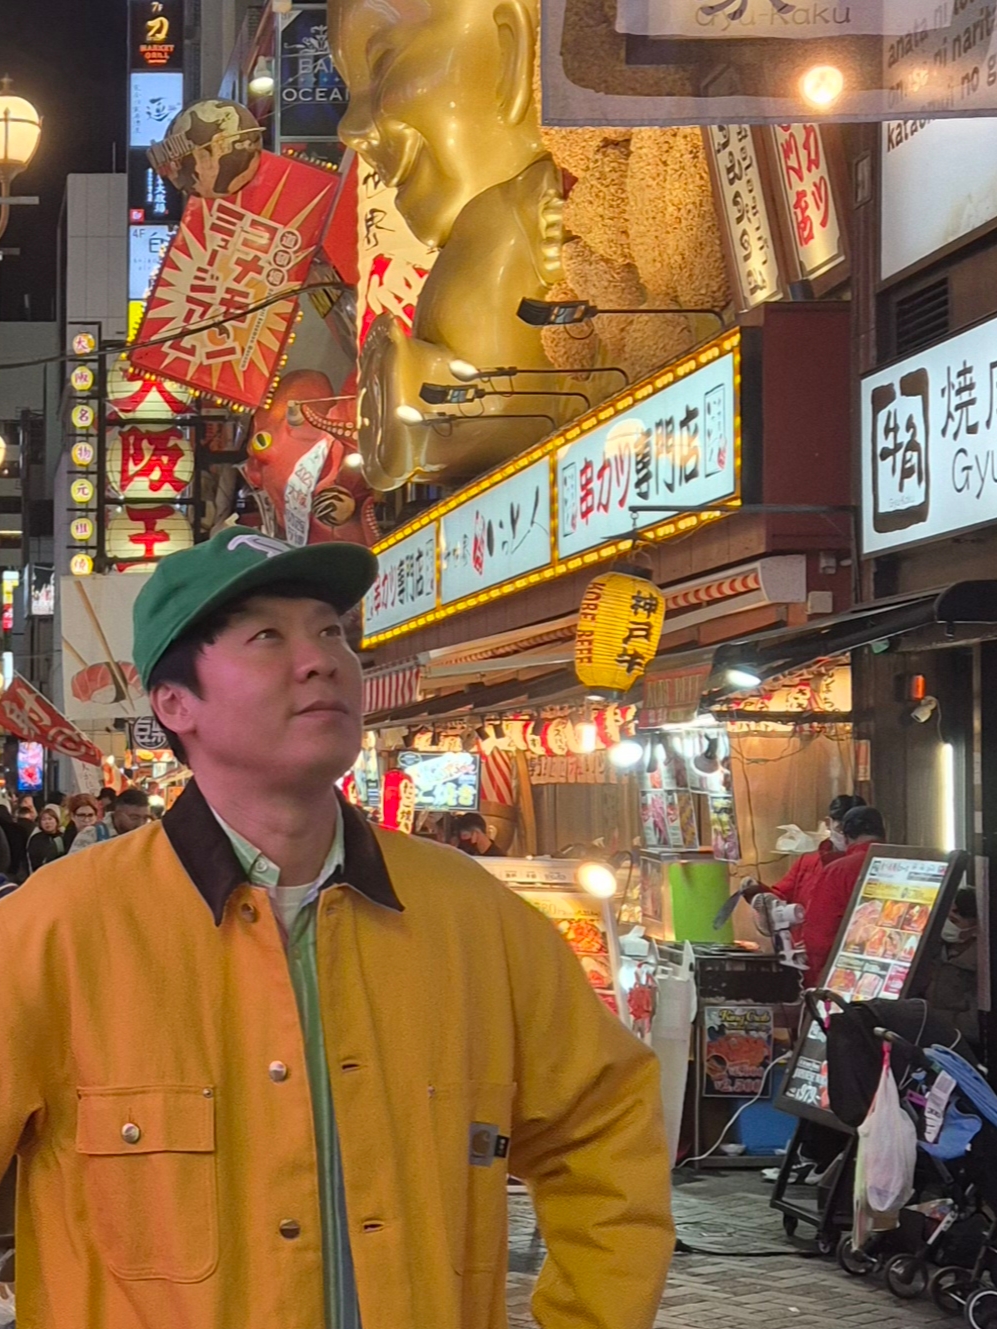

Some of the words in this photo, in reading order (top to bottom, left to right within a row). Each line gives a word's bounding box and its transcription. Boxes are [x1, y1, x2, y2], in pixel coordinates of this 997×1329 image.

[133, 229, 145, 238] 4F
[579, 404, 700, 527] 串カツ専門店
[615, 589, 659, 674] 神戸牛
